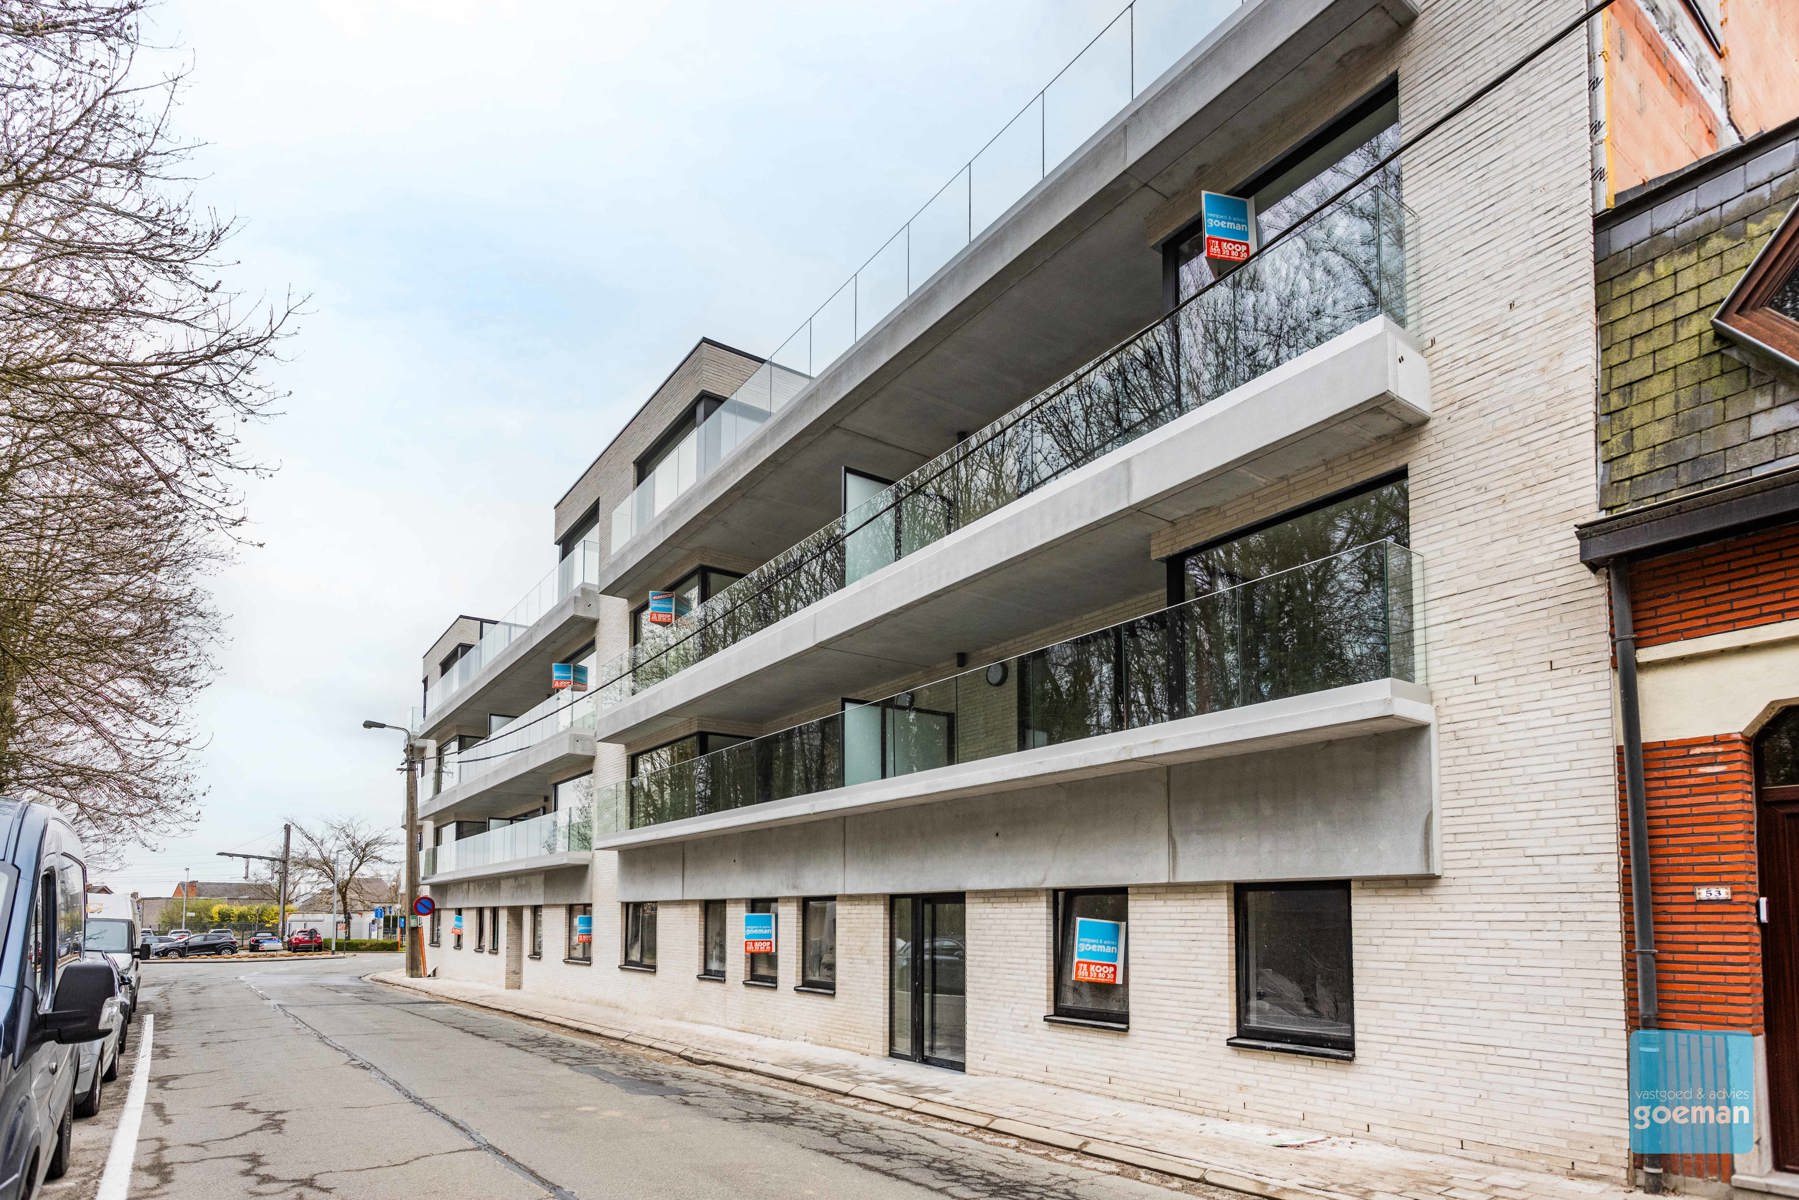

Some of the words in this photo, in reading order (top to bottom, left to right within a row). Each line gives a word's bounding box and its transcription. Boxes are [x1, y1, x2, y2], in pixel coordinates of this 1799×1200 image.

[1207, 218, 1248, 232] goeman
[1221, 241, 1247, 252] KOOP
[1705, 889, 1722, 897] 53
[1078, 943, 1117, 954] goeman
[1090, 964, 1114, 973] KOOP
